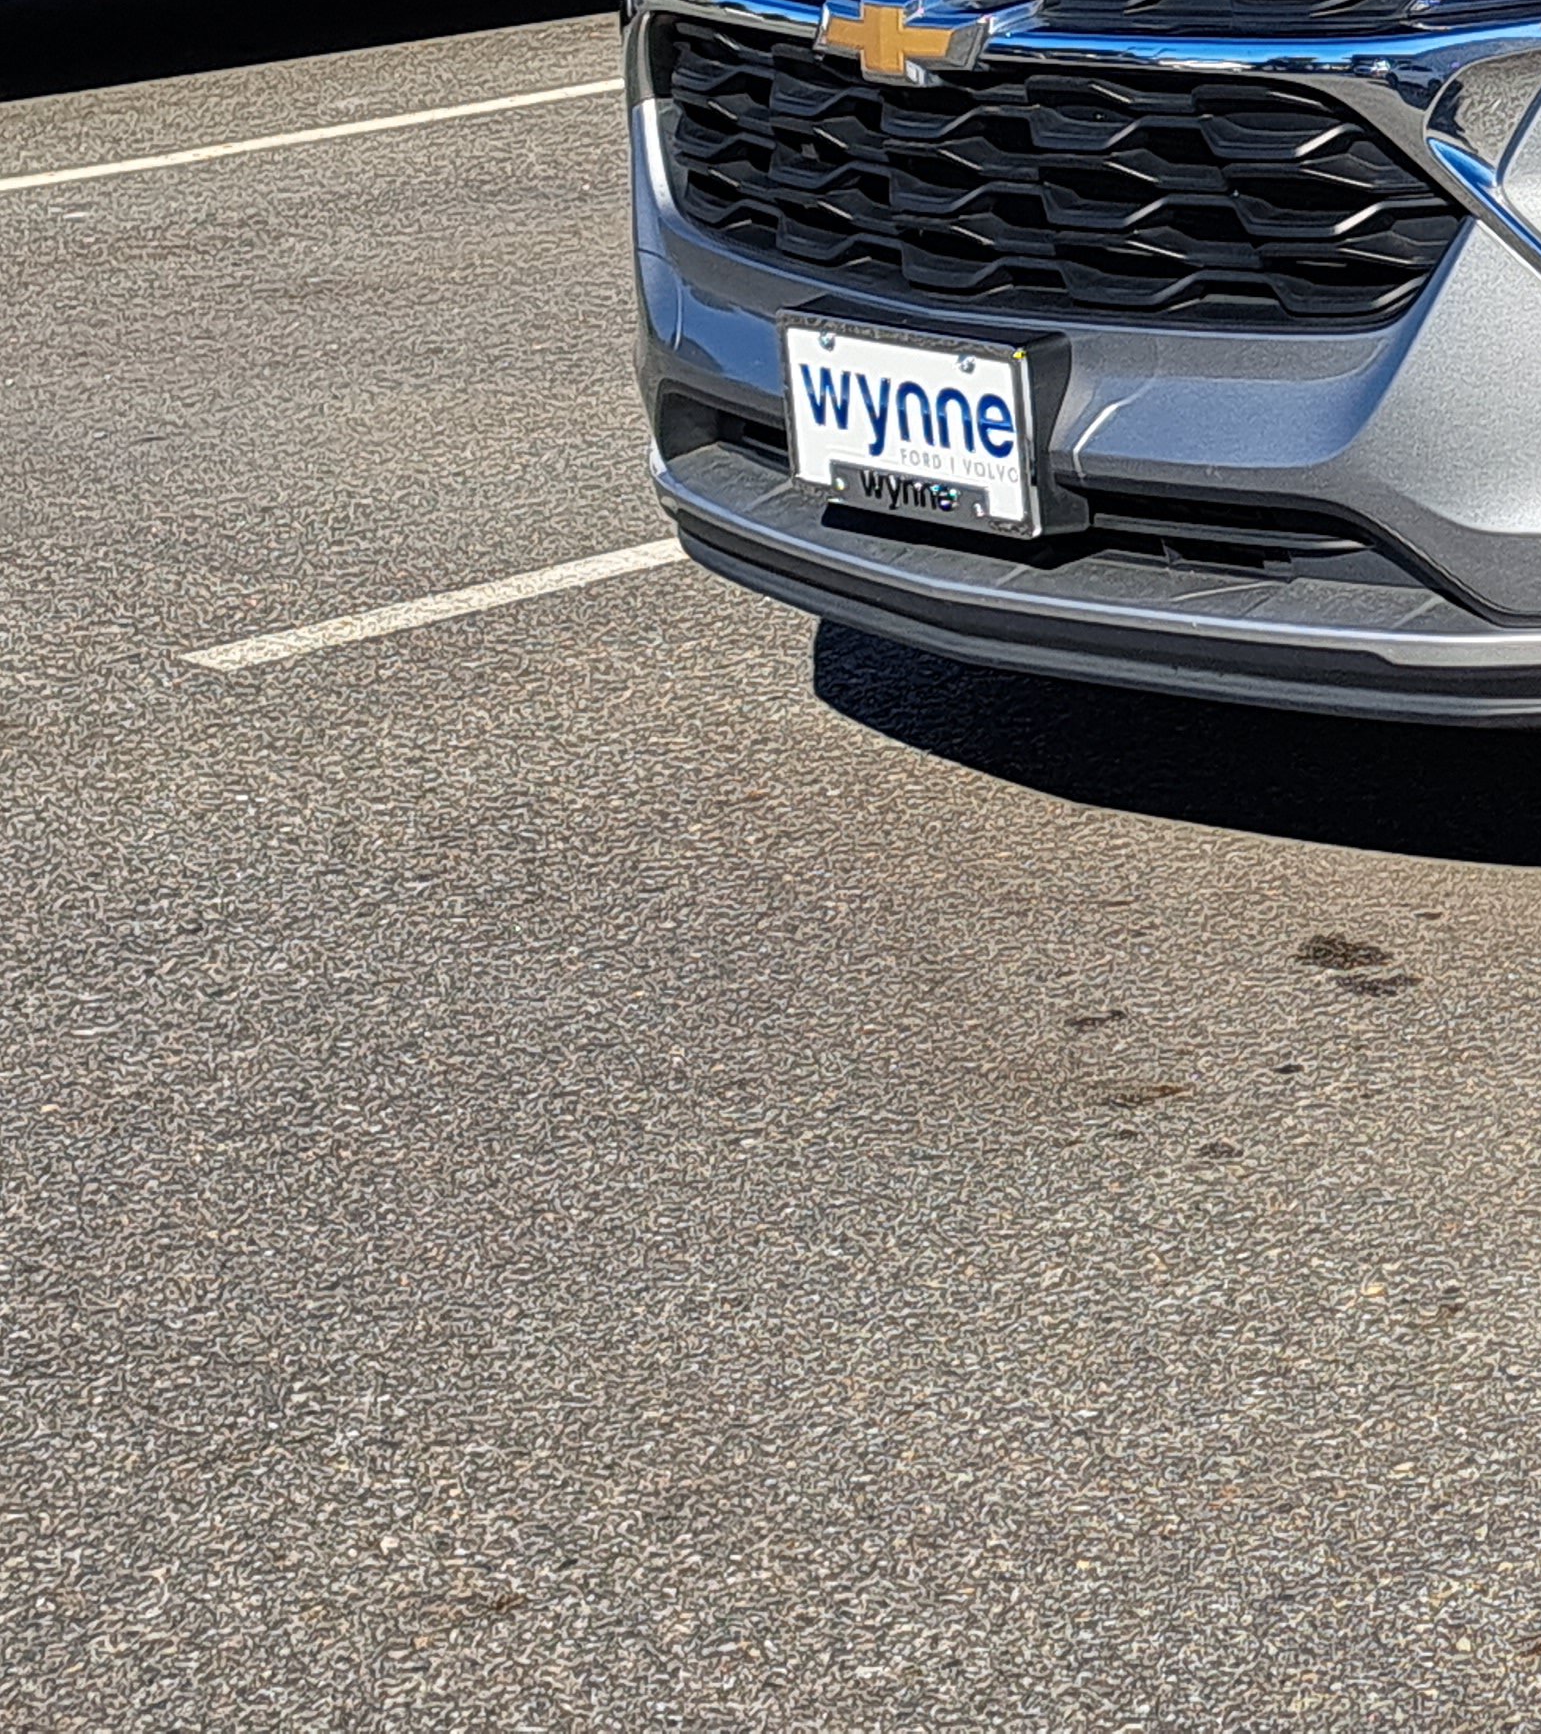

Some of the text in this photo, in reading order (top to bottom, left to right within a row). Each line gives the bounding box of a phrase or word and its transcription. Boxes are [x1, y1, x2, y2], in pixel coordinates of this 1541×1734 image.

[799, 363, 1016, 459] wynne
[898, 447, 943, 471] FORD
[860, 469, 958, 512] wynne
